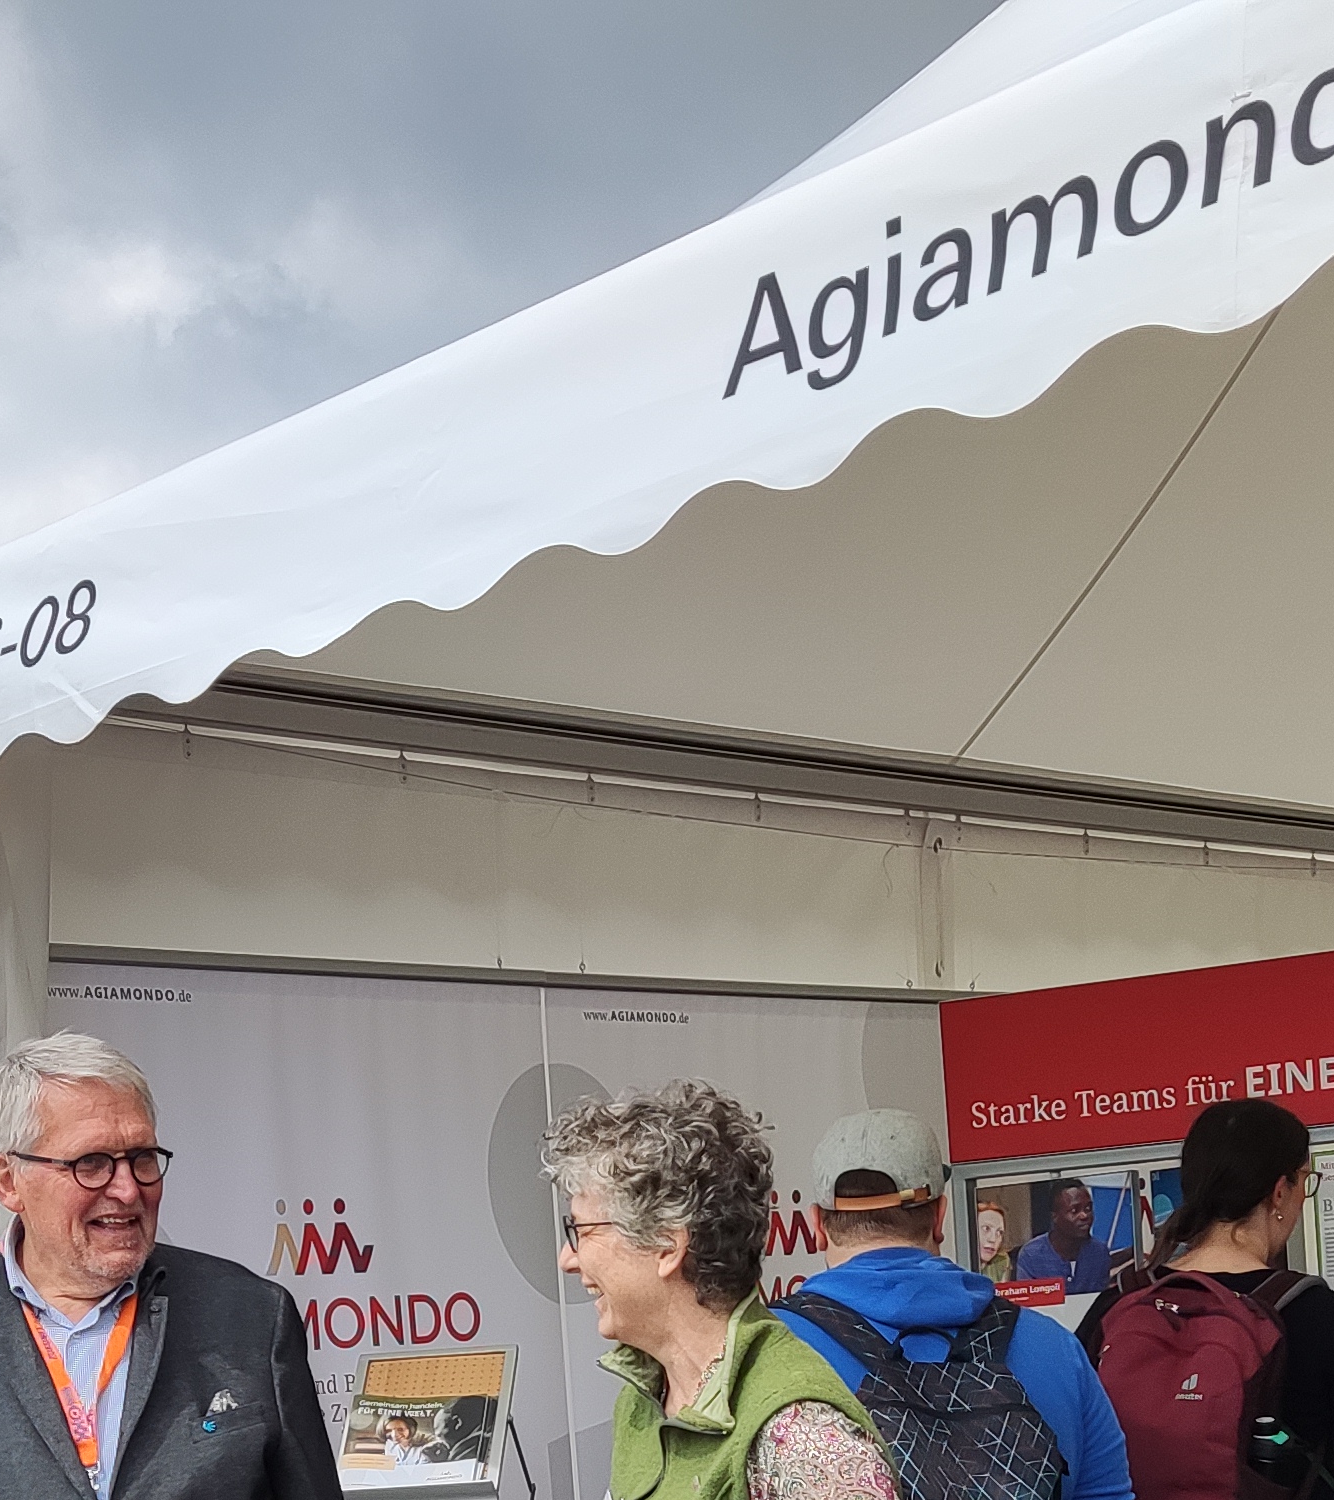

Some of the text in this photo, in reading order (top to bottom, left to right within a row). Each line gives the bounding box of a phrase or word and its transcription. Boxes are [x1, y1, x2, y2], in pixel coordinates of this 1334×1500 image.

[47, 985, 192, 1003] www.AGIAMONDO.de
[583, 1010, 690, 1024] www.AGIAMONDO.de
[971, 1095, 1067, 1129] Starke
[1074, 1084, 1176, 1118] Teams
[1184, 1076, 1235, 1105] für
[1320, 1161, 1334, 1171] Mit
[994, 1287, 1028, 1297] braham
